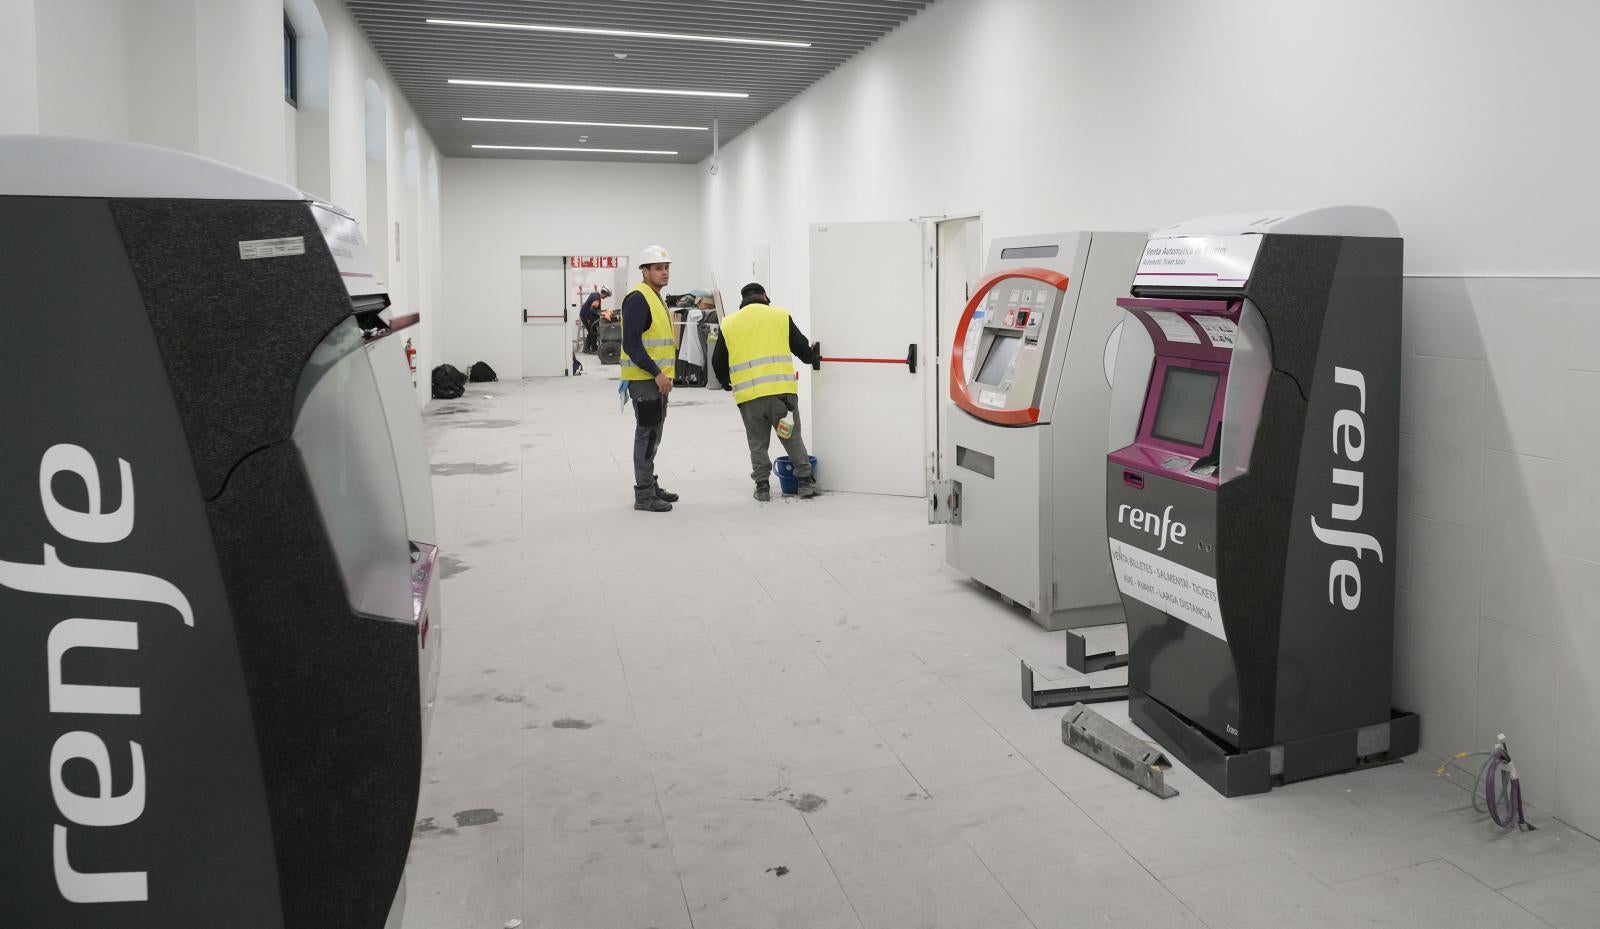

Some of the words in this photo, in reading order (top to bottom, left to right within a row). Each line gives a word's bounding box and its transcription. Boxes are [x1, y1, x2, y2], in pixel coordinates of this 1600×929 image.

[1146, 247, 1162, 256] Venta
[1310, 365, 1384, 612] renfe
[1118, 503, 1187, 551] renfe
[1112, 551, 1128, 564] VENTA
[1128, 556, 1153, 575] BILLETES
[1191, 582, 1217, 602] TICKETS
[1158, 588, 1179, 606] LARGA
[1178, 598, 1213, 620] DISTANCIA
[0, 443, 195, 904] renfe
